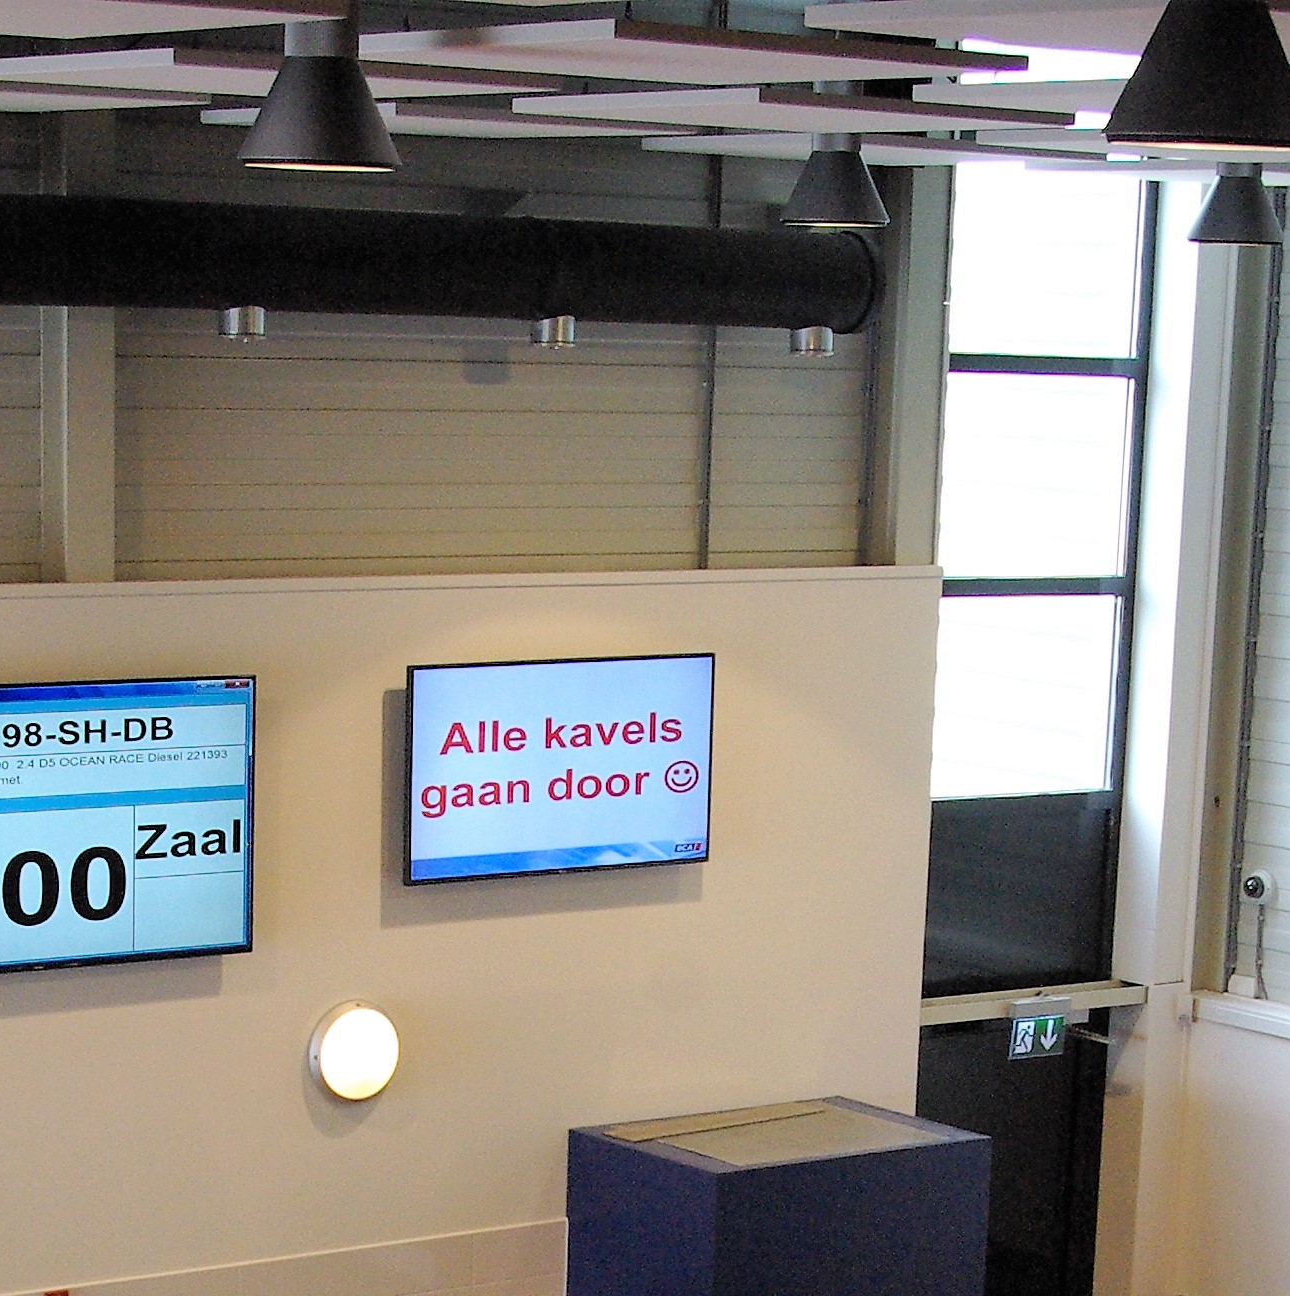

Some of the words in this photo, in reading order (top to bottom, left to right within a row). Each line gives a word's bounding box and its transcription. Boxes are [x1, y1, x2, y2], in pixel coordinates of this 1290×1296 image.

[2, 716, 174, 748] 98-SH-DB
[440, 720, 527, 755] Alle
[545, 711, 683, 749] kavels
[16, 759, 34, 770] 2.4
[39, 758, 56, 768] D5
[59, 756, 105, 767] OCEAN
[109, 753, 144, 764] RACE
[148, 751, 183, 762] Diesel
[187, 750, 228, 761] 221393
[421, 778, 530, 818] gaan
[548, 768, 650, 802] door
[136, 819, 242, 860] Zaal
